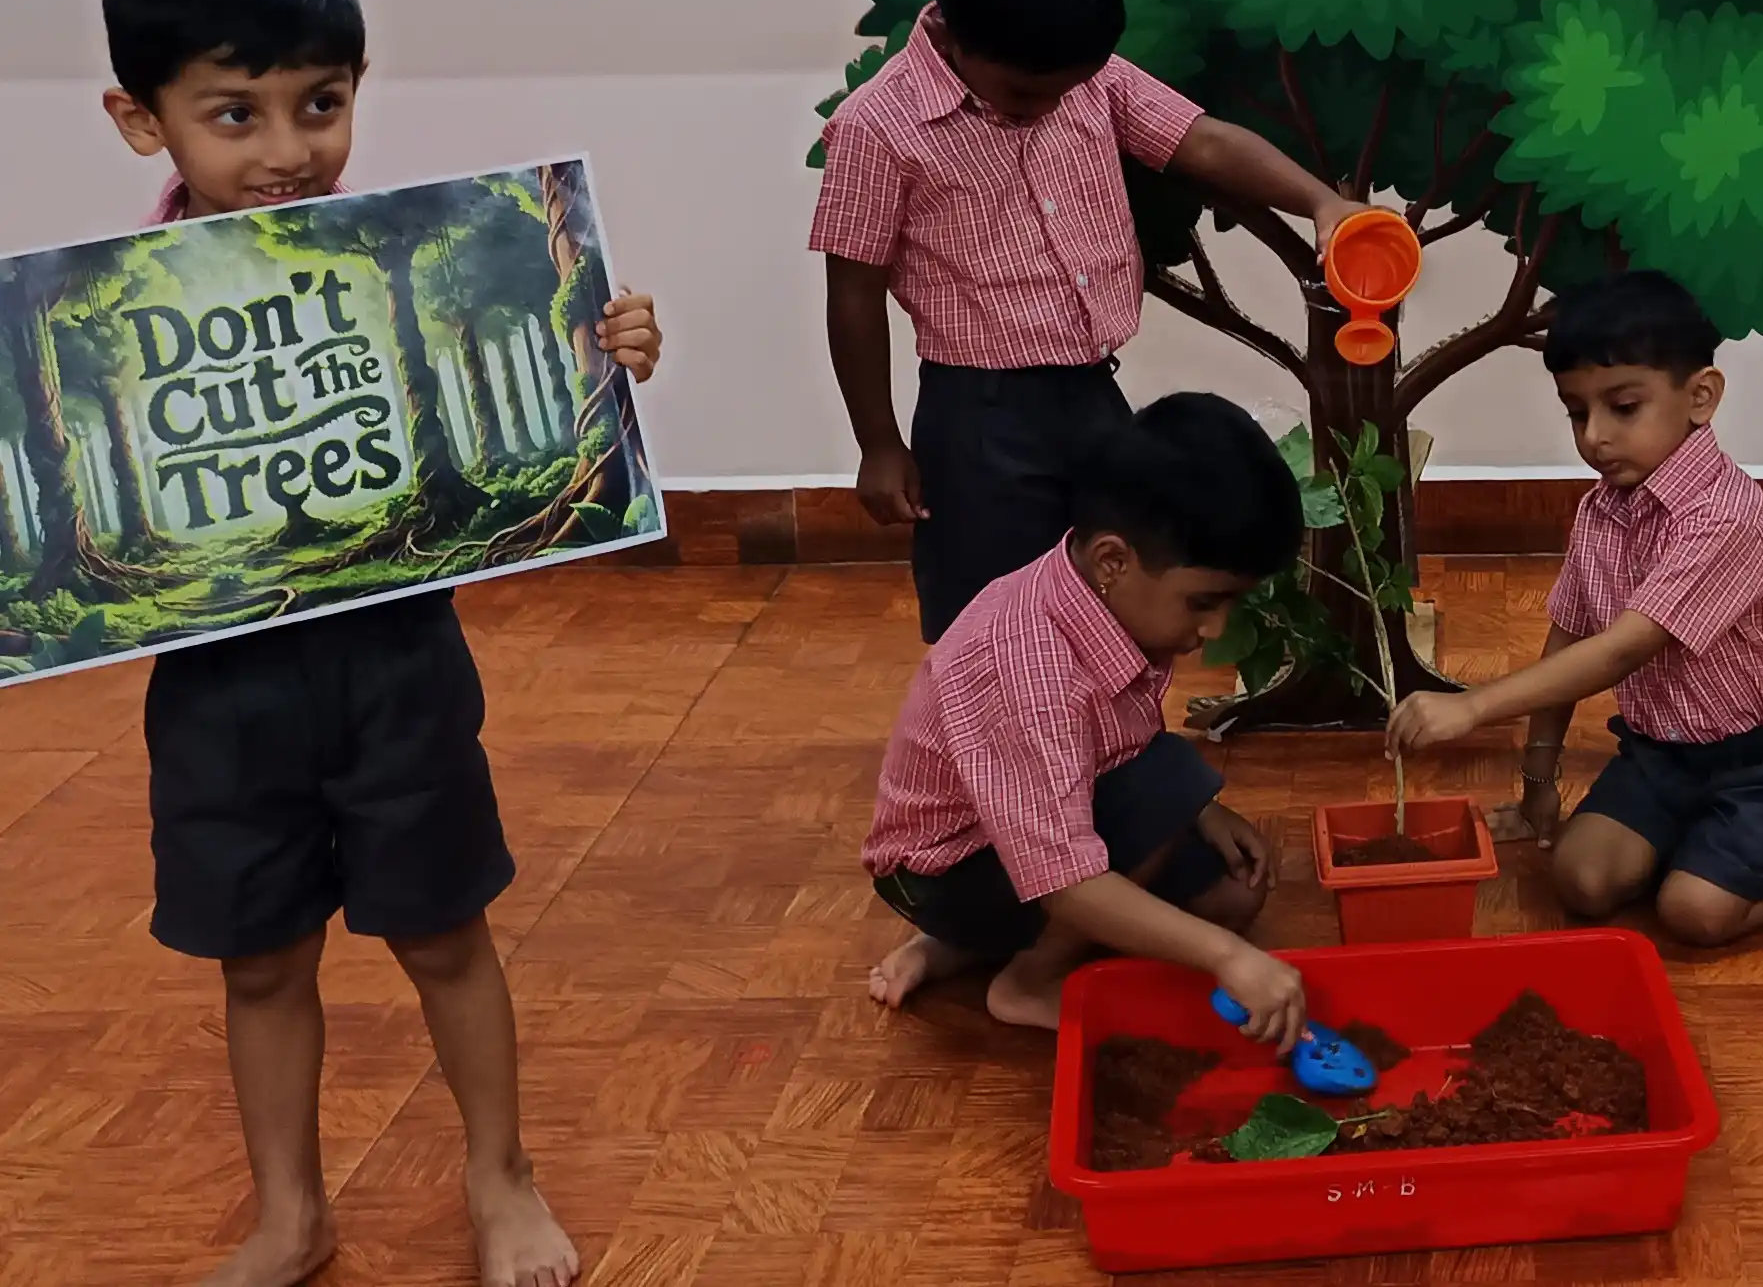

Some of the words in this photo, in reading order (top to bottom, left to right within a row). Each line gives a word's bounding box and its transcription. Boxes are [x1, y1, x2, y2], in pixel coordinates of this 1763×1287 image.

[121, 270, 358, 380] Don't
[147, 355, 299, 445] Cut
[156, 427, 403, 531] Trees
